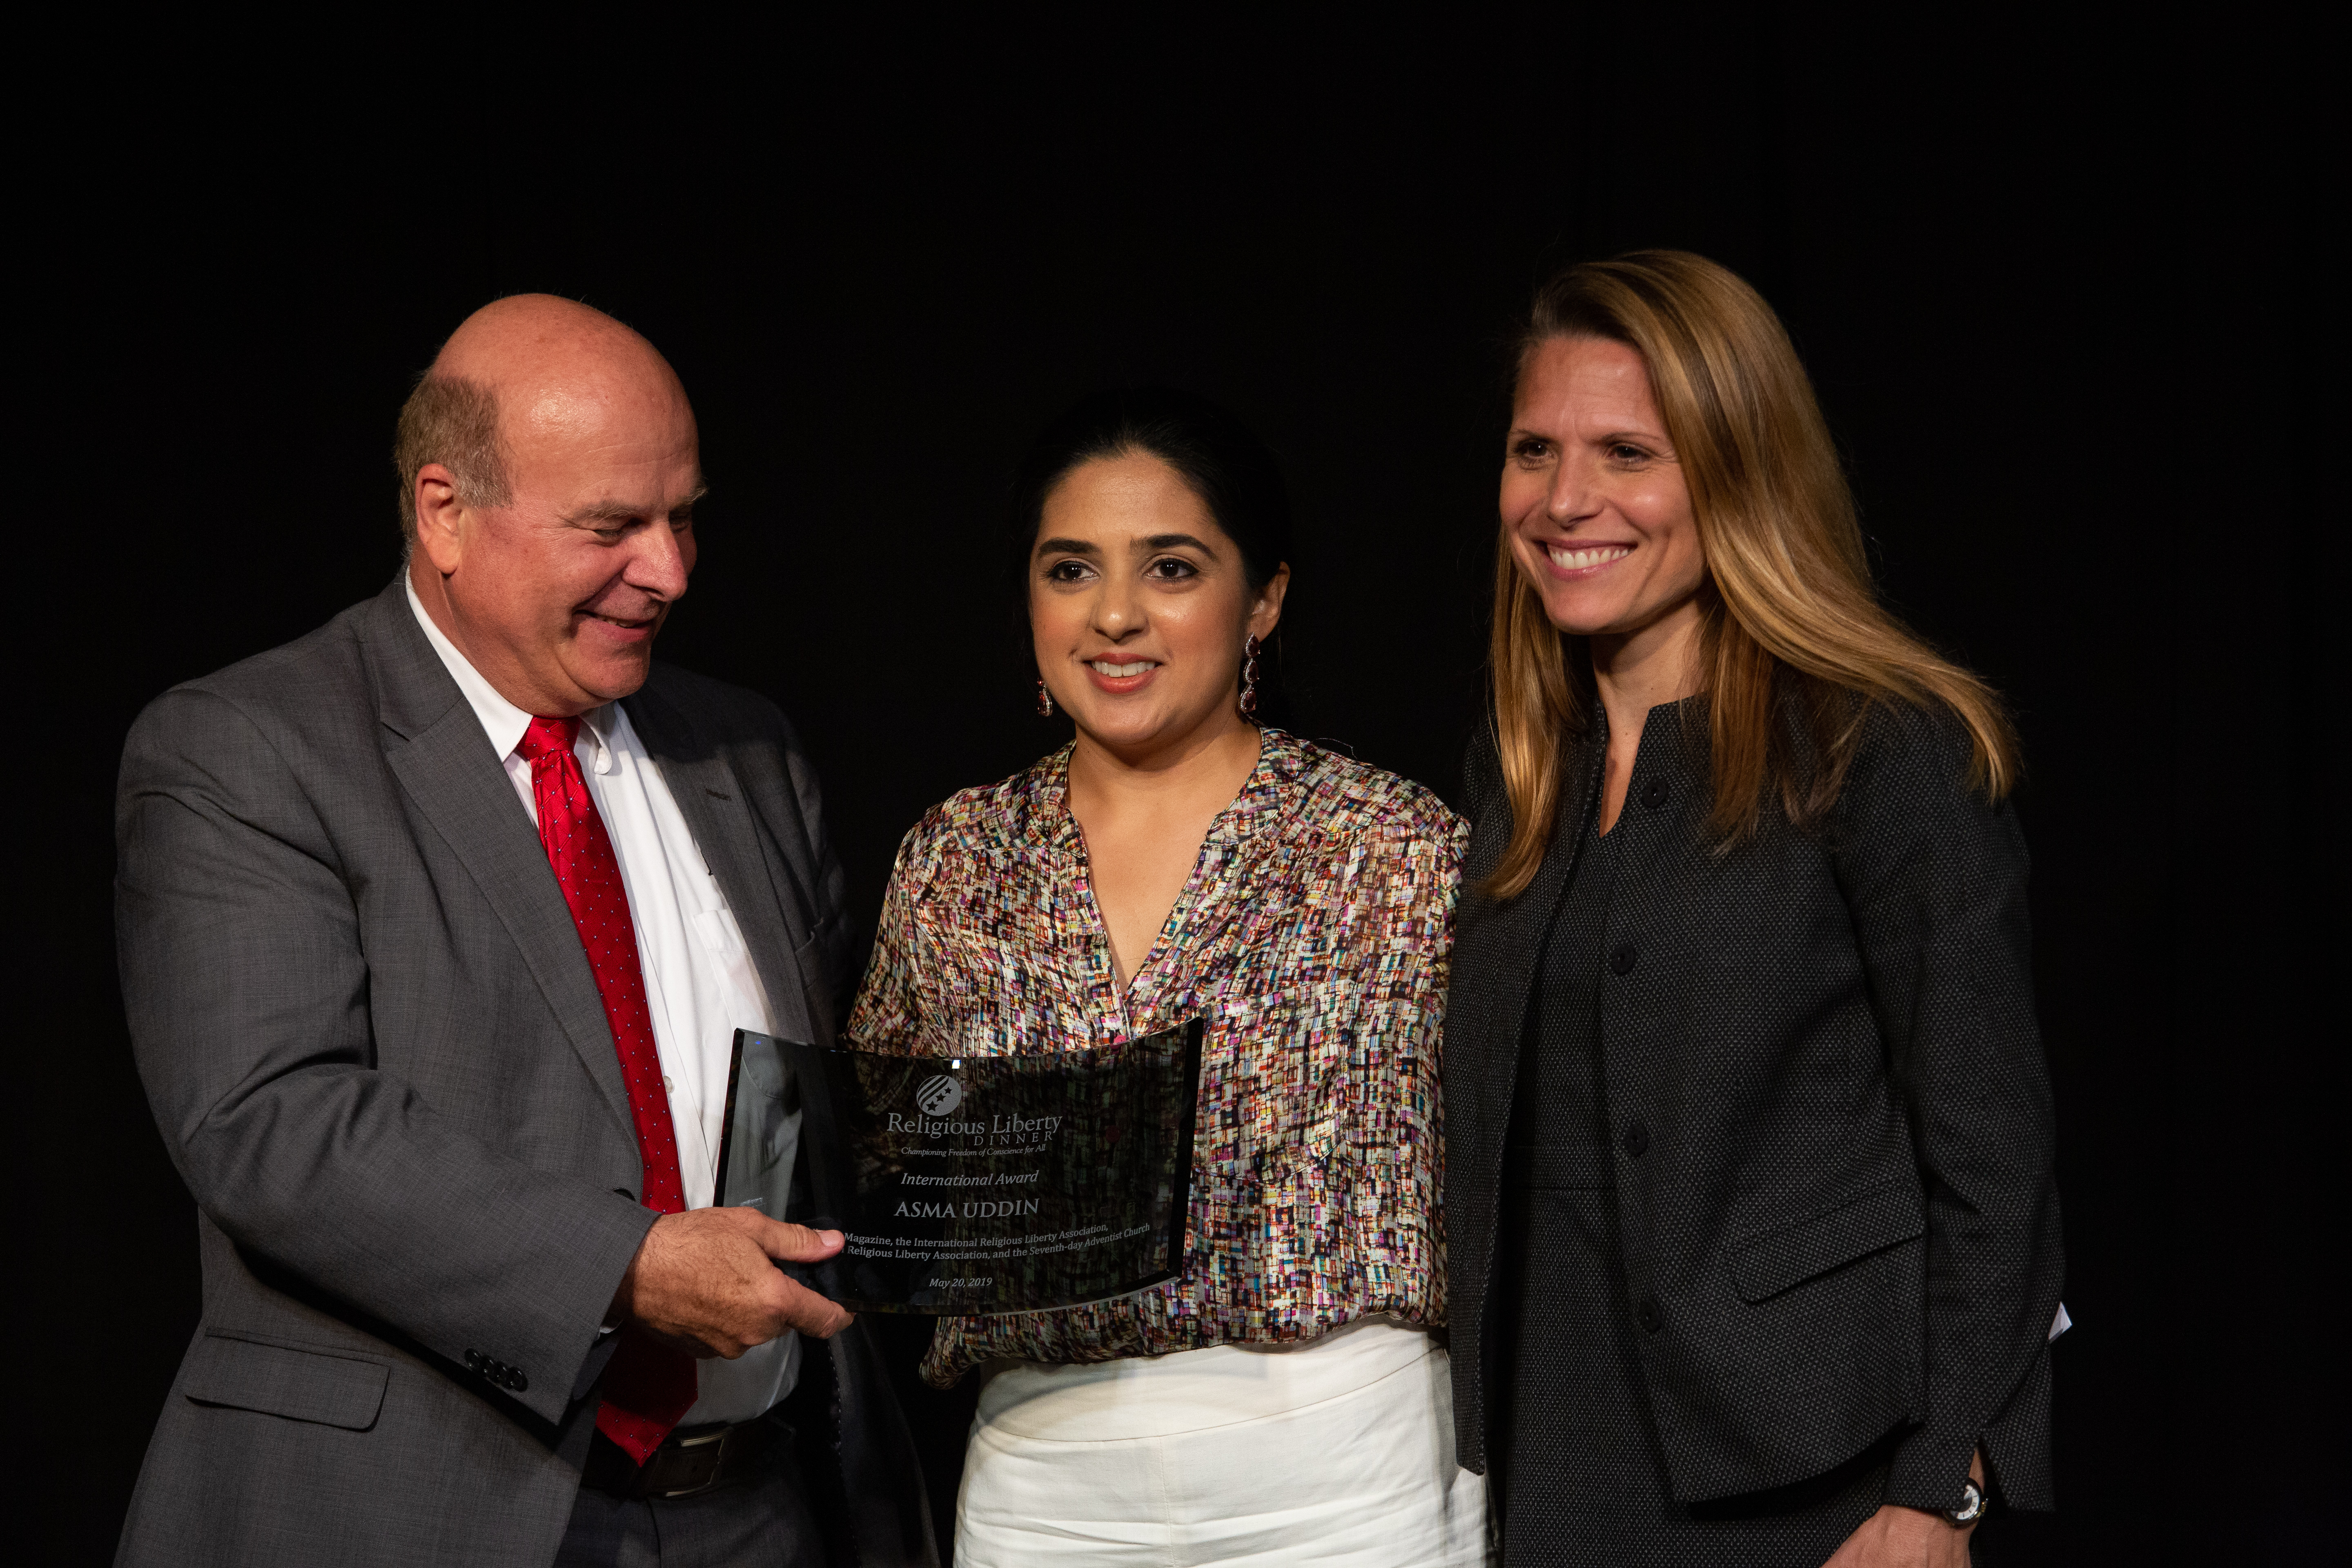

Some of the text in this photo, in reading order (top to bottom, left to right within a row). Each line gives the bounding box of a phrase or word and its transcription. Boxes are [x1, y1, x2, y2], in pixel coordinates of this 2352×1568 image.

[886, 1112, 1062, 1138] Religious Liberty
[974, 1131, 1053, 1146] DINNER
[901, 1147, 946, 1157] Championing
[901, 1170, 1039, 1186] International Award
[893, 1198, 1040, 1218] ASMA UDDIN
[844, 1224, 1108, 1247] Magazine, the International Religious Liberty Association,
[847, 1246, 893, 1258] Religious
[895, 1250, 931, 1261] Liberty
[933, 1251, 991, 1260] Association,
[992, 1247, 1010, 1258] and
[1012, 1247, 1027, 1256] the
[1029, 1241, 1083, 1256] Seventh-day
[1084, 1232, 1123, 1246] Adventist
[1124, 1223, 1150, 1238] Church
[929, 1277, 993, 1289] May 20, 2019
